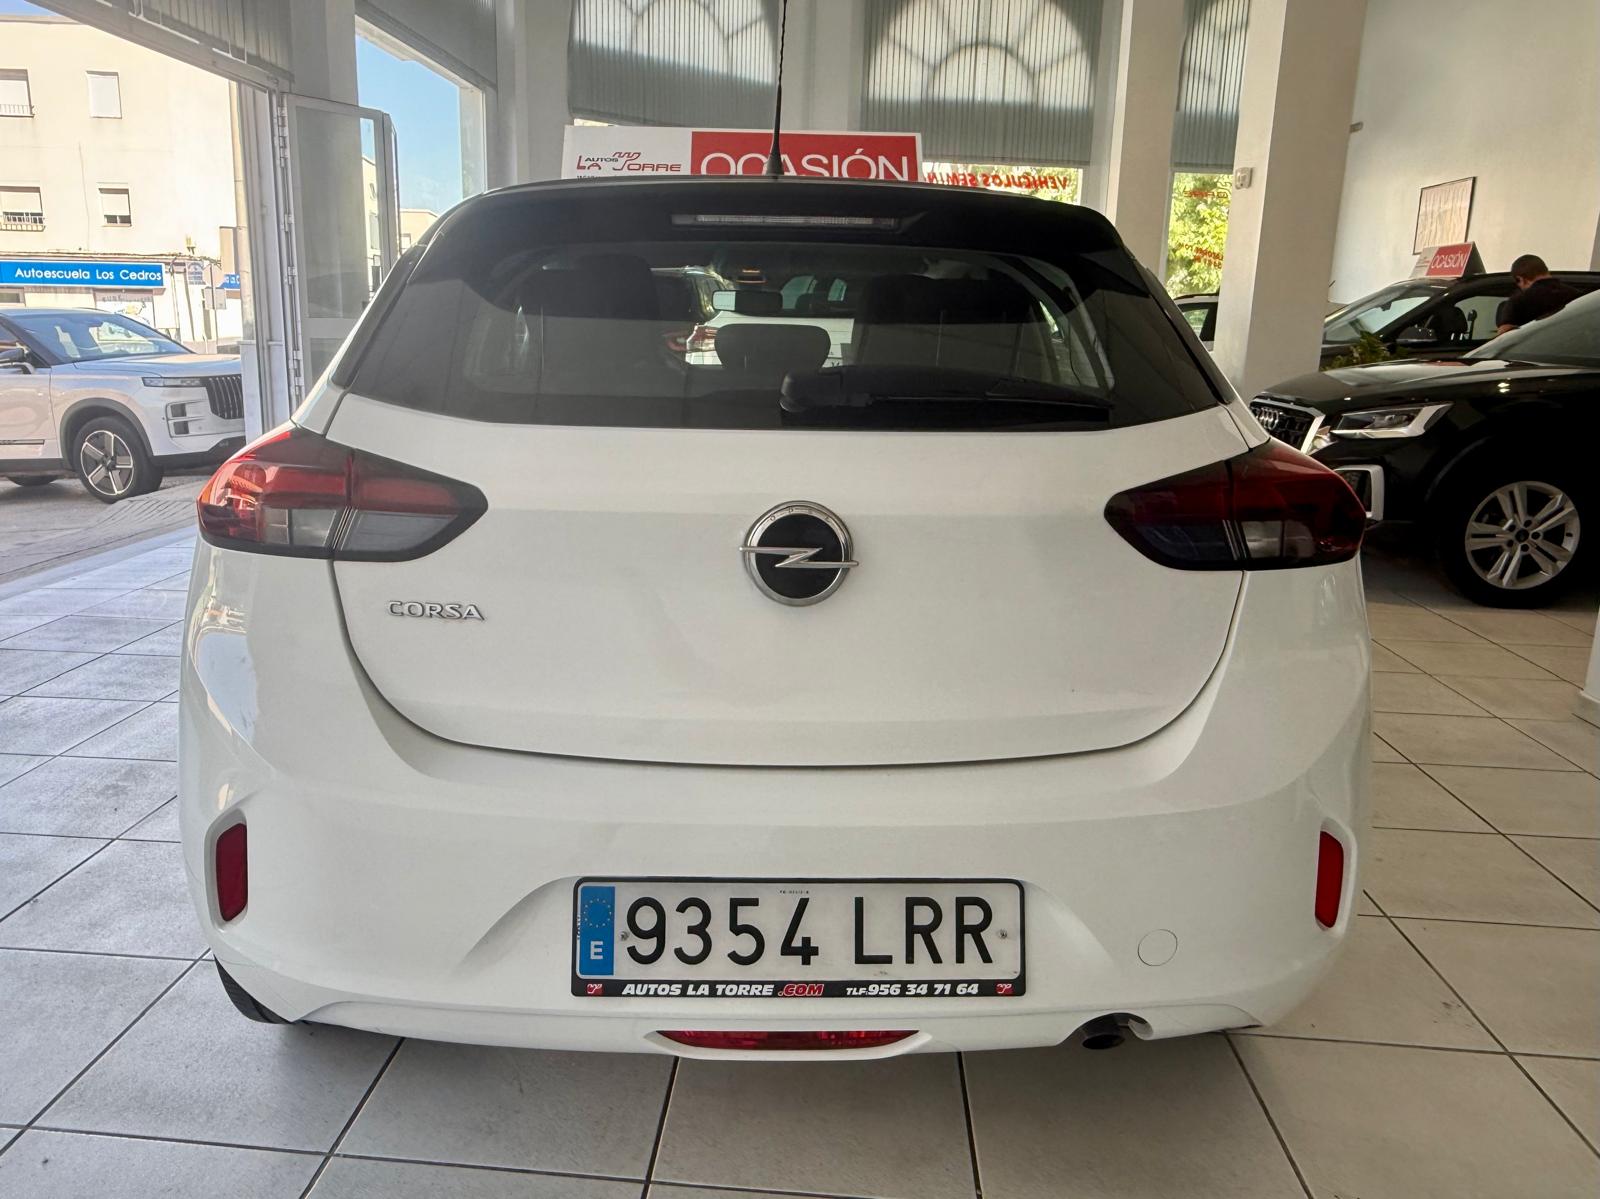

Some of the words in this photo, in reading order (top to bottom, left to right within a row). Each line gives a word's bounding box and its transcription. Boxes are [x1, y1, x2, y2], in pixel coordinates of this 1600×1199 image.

[576, 155, 602, 171] LA
[700, 148, 908, 182] OCASIÓN
[1430, 251, 1467, 269] OCASIÓN
[15, 267, 90, 280] Autoescuela
[96, 269, 114, 280] Los
[120, 269, 162, 281] Cedros
[387, 600, 485, 621] CORSA
[626, 896, 819, 966] 9354
[854, 896, 993, 965] LRR
[590, 940, 604, 960] E
[621, 983, 683, 996] AUTOS
[686, 983, 707, 996] LA
[711, 983, 775, 996] TORRE
[905, 983, 929, 996] 34
[933, 983, 952, 996] 71
[956, 983, 979, 996] 64
